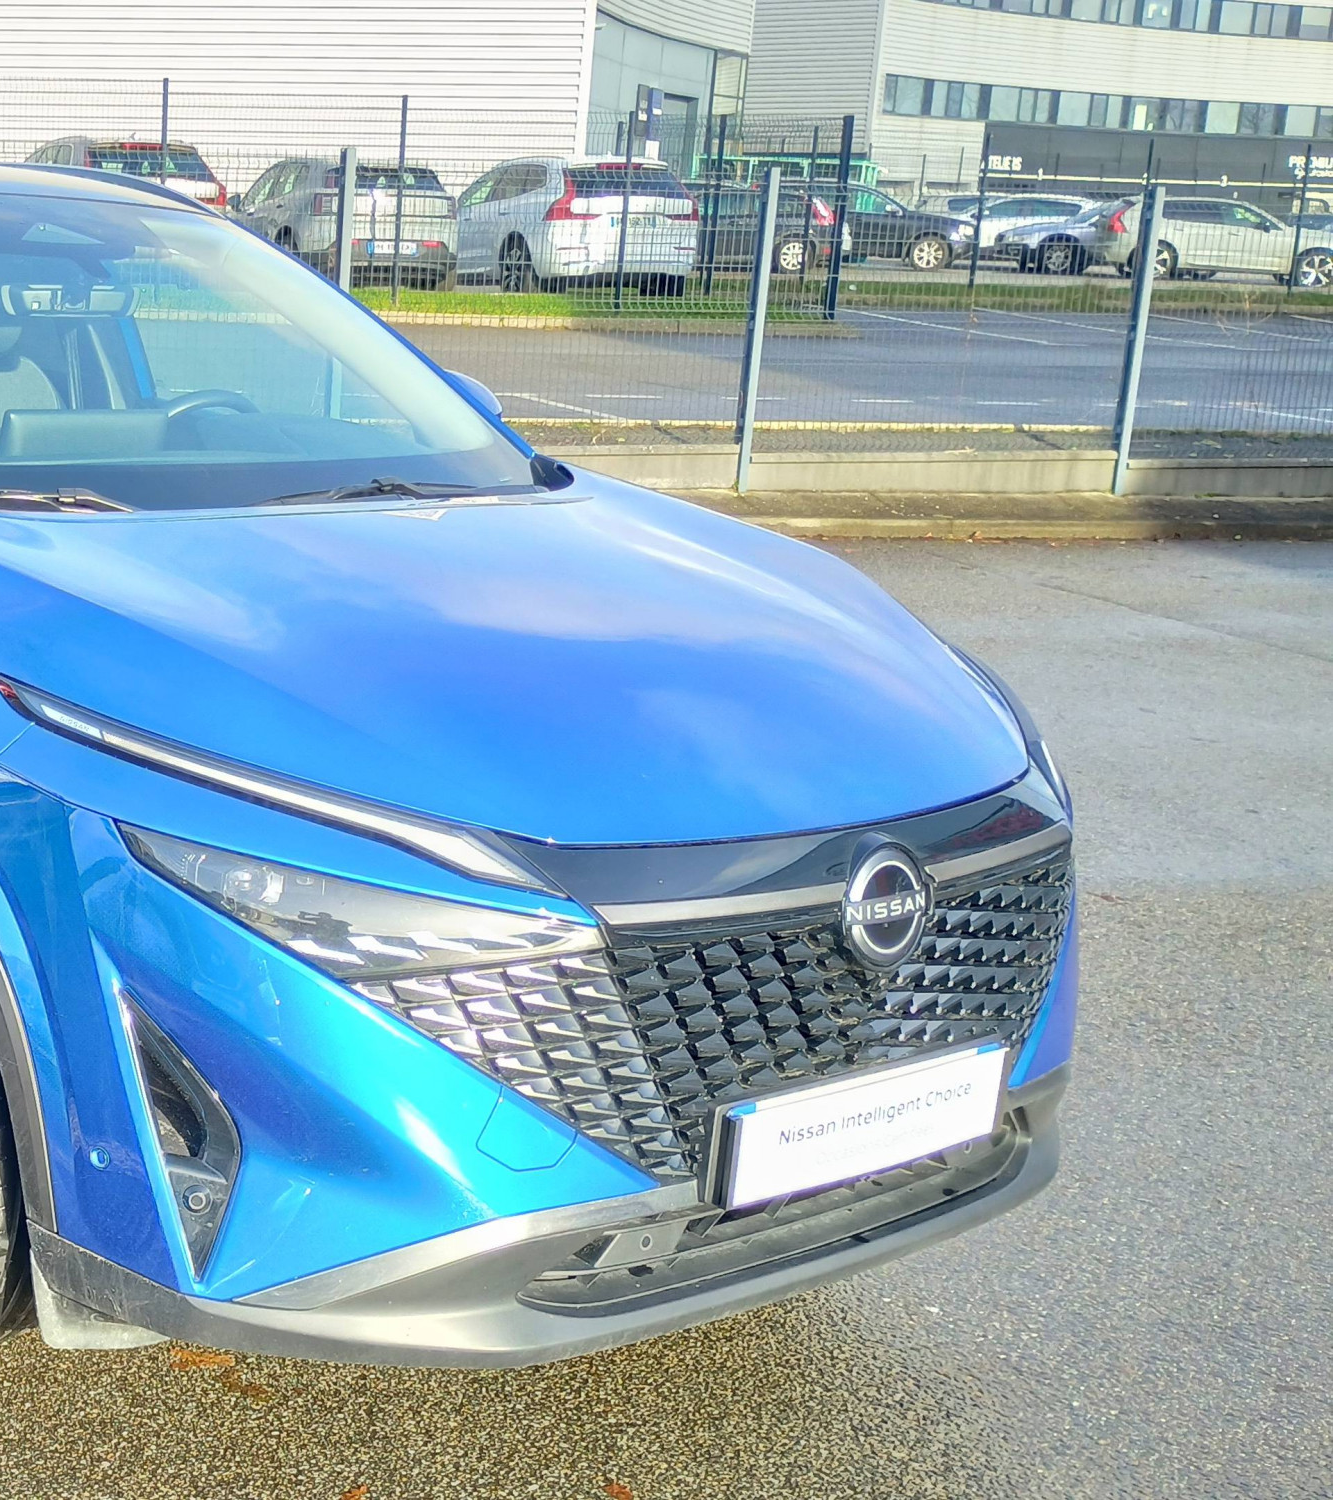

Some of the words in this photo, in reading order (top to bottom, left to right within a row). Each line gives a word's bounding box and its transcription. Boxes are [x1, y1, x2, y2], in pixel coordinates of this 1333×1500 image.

[846, 891, 925, 922] NISSAN
[778, 1119, 836, 1145] Nissan
[841, 1095, 921, 1130] Intelligent
[925, 1081, 972, 1107] Choice
